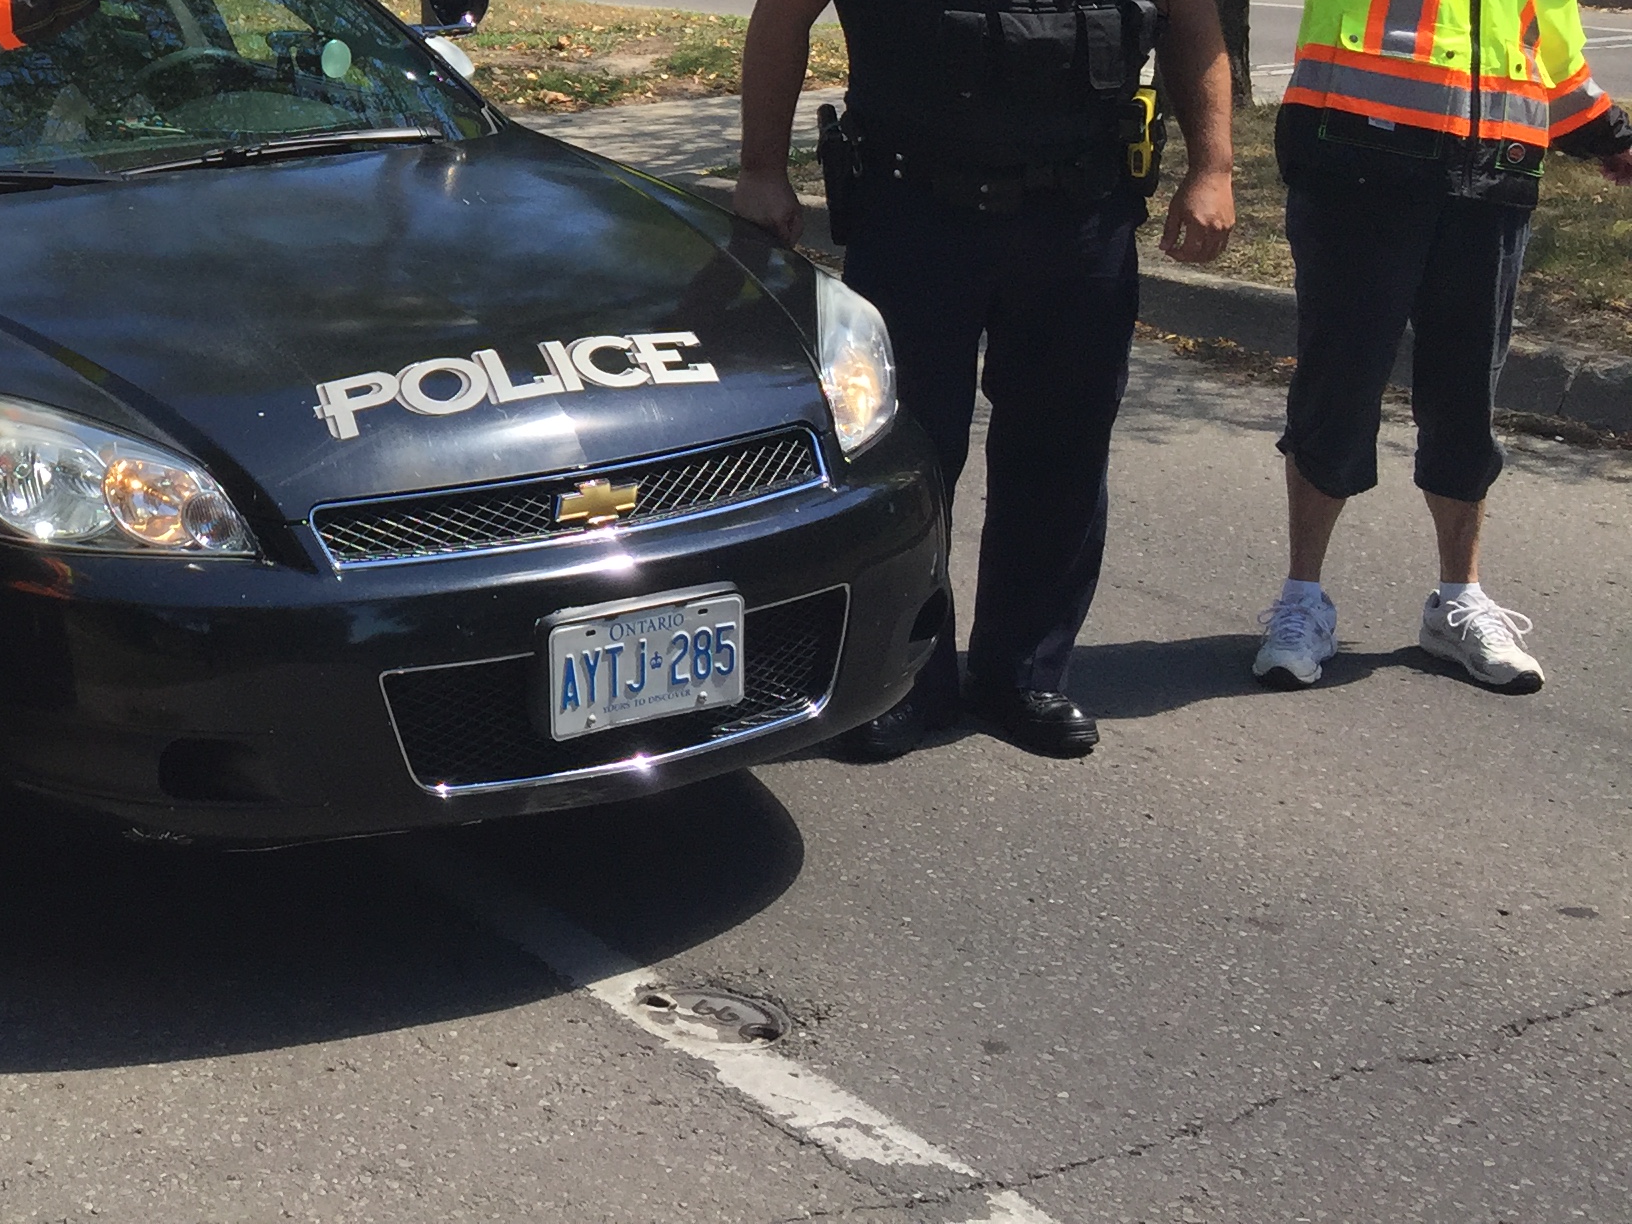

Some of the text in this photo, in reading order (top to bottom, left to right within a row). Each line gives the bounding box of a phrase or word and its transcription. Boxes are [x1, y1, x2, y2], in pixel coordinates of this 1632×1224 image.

[314, 331, 719, 440] POLICE
[562, 621, 736, 710] AYTJ 285
[602, 688, 691, 714] YOURS TO DISCOVER
